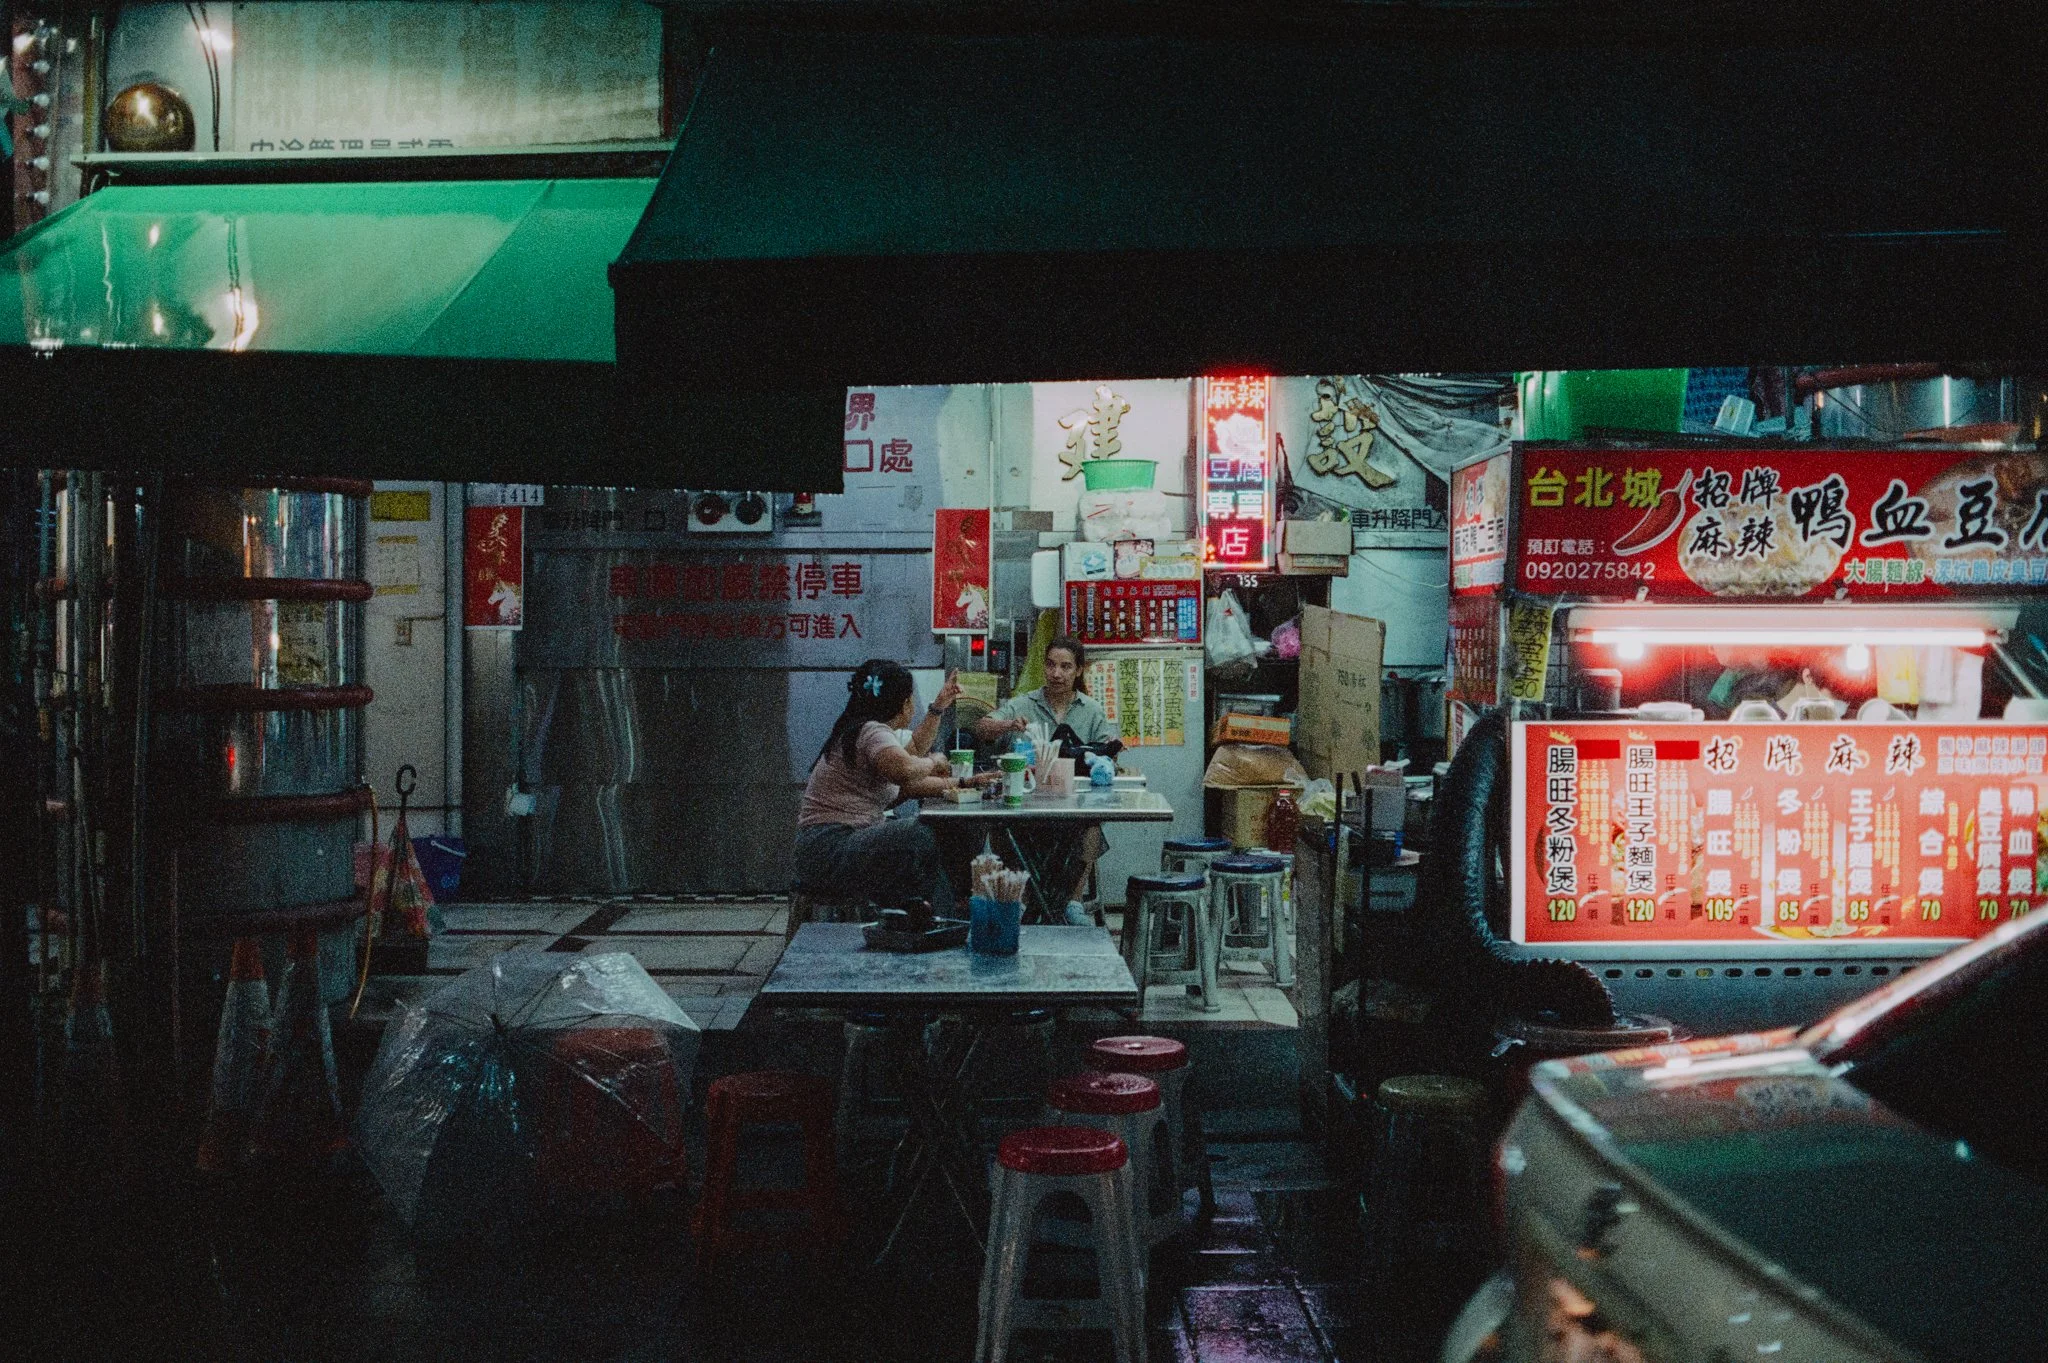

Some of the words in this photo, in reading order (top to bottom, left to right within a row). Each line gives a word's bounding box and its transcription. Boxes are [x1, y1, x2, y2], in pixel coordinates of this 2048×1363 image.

[1207, 381, 1265, 409] 麻辣
[1058, 384, 1131, 481] 建
[1207, 454, 1265, 482] 豆腐
[510, 488, 540, 502] 414
[1528, 466, 1662, 508] 台北城
[1695, 468, 1779, 509] 招牌
[1791, 478, 2048, 549] 鴨血豆
[1220, 527, 1249, 556] 店
[1690, 516, 1775, 558] 麻辣
[1525, 561, 1656, 580] 0920275842
[1706, 737, 1921, 773] 招牌麻辣
[1548, 746, 1577, 893] 腸旺冬粉煲
[1627, 747, 1656, 893] 腸旺王子麵煲
[1548, 899, 1576, 921] 120
[1627, 899, 1655, 921] 120
[1706, 898, 1735, 921] 105
[1779, 901, 1799, 921] 85
[1849, 900, 1869, 921] 85
[1921, 900, 1940, 921] 70
[1980, 900, 1999, 920] 70
[2010, 900, 2030, 920] 70
